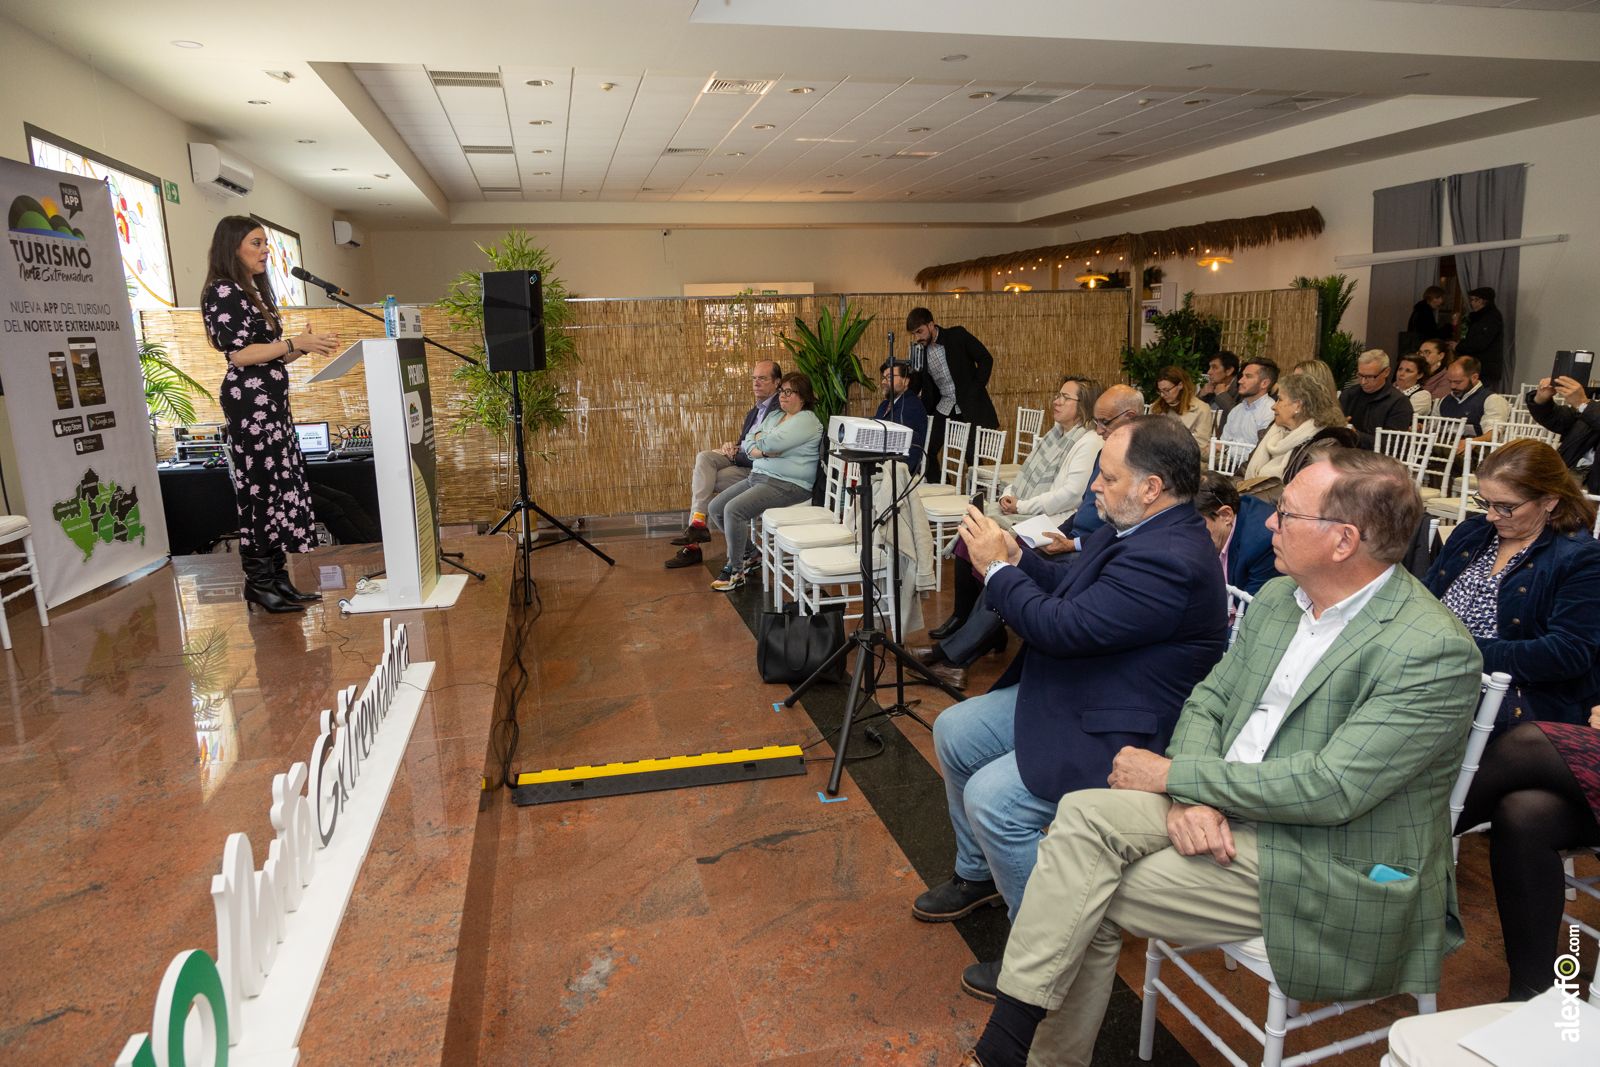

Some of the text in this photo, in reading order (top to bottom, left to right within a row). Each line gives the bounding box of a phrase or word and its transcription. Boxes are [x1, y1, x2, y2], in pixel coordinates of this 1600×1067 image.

[64, 195, 79, 206] APP
[9, 239, 92, 269] TURISMO
[18, 262, 94, 283] Norte Extremadura
[10, 301, 111, 315] NUEVA APP DEL TURISMO
[4, 319, 120, 333] DEL NORTE DE EXTREMADURA
